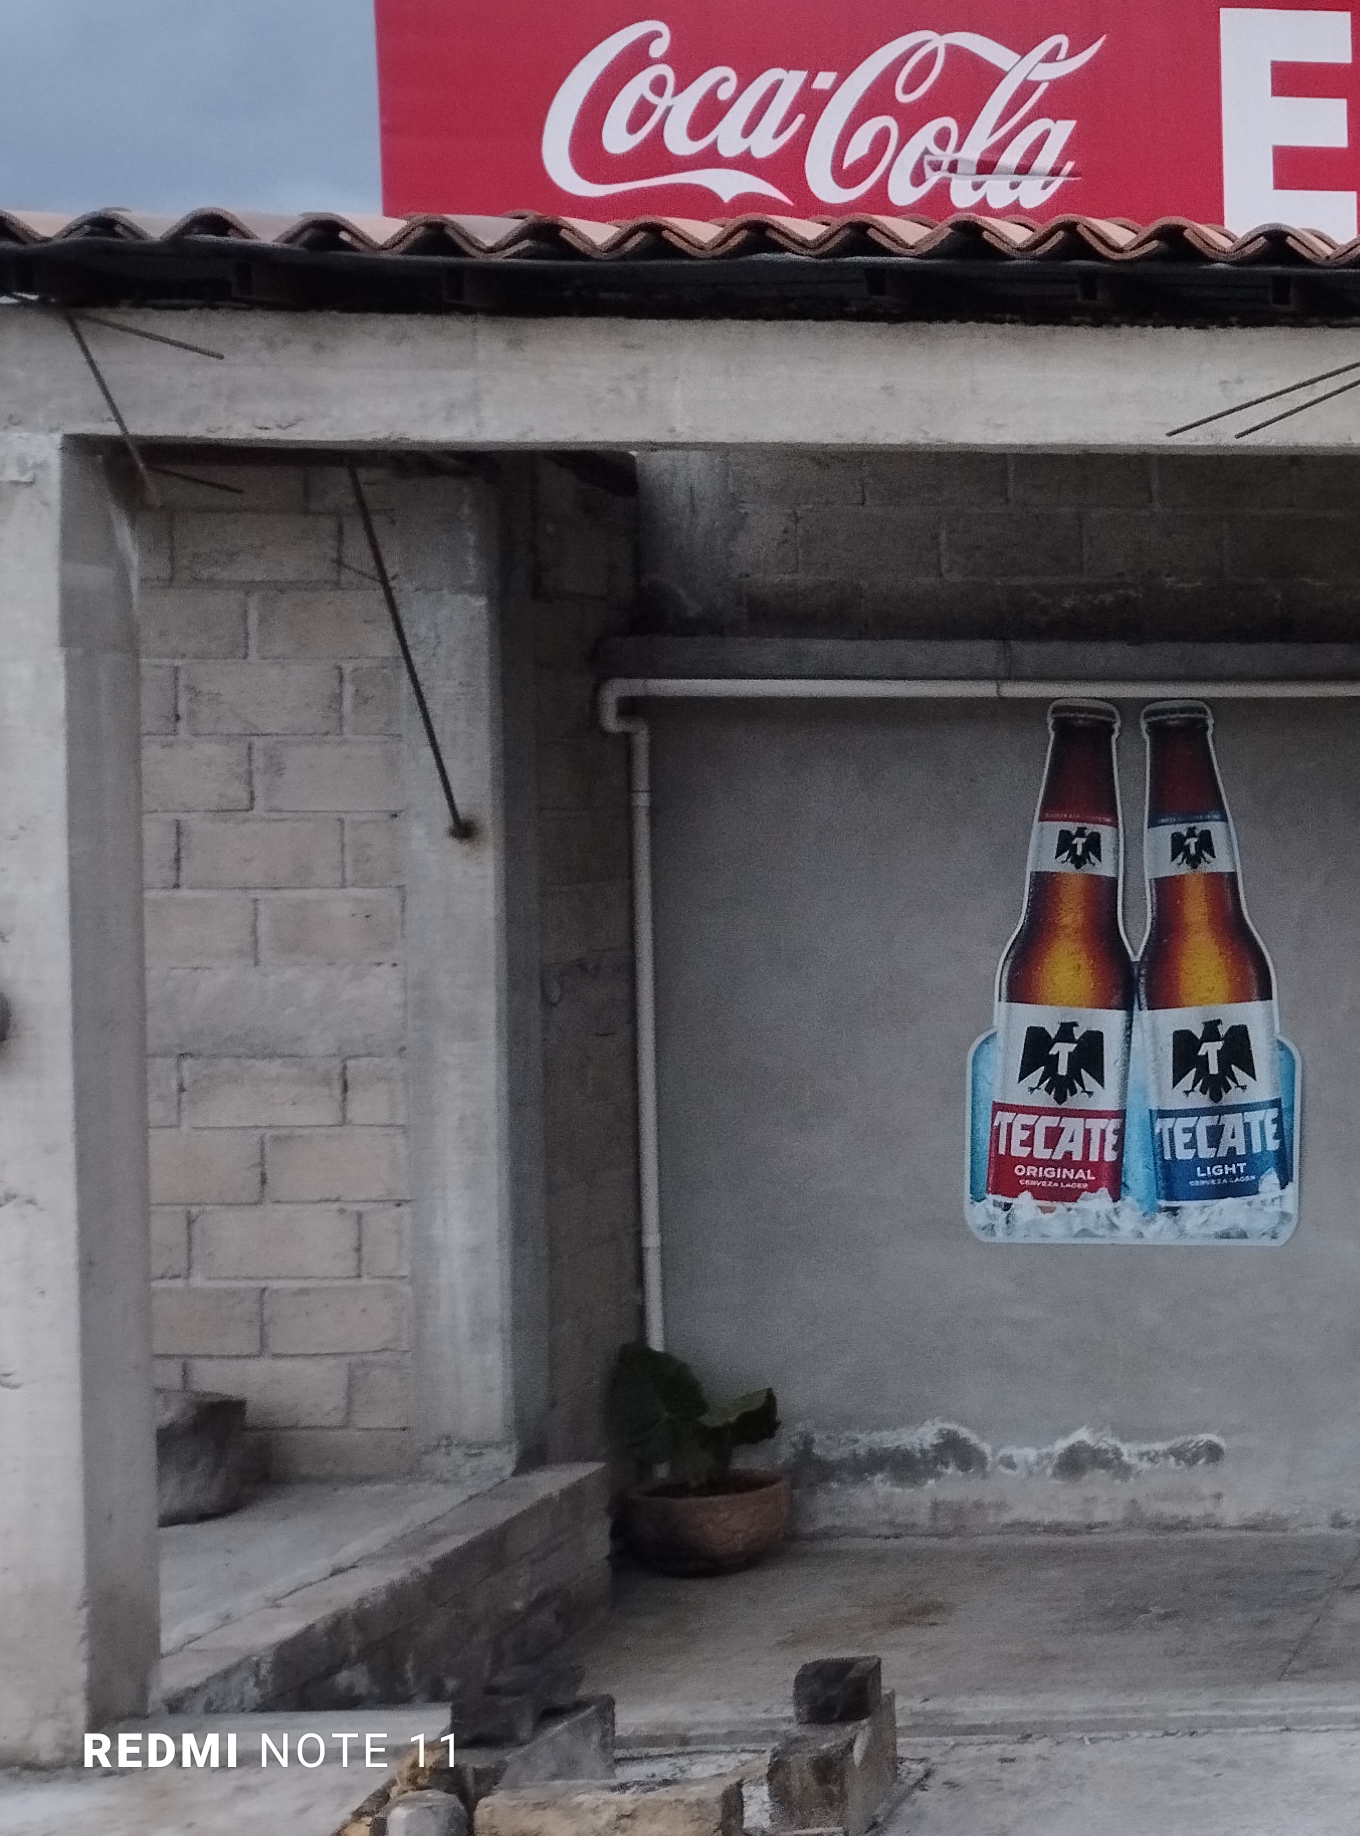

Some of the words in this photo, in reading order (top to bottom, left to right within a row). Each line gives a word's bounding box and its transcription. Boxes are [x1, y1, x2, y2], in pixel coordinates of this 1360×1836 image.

[541, 20, 1107, 207] Coca-Cola
[993, 1110, 1124, 1162] TECATE
[1155, 1107, 1281, 1161] TECATE
[1014, 1164, 1096, 1181] ORIGINAL
[1196, 1162, 1247, 1178] LIGHT
